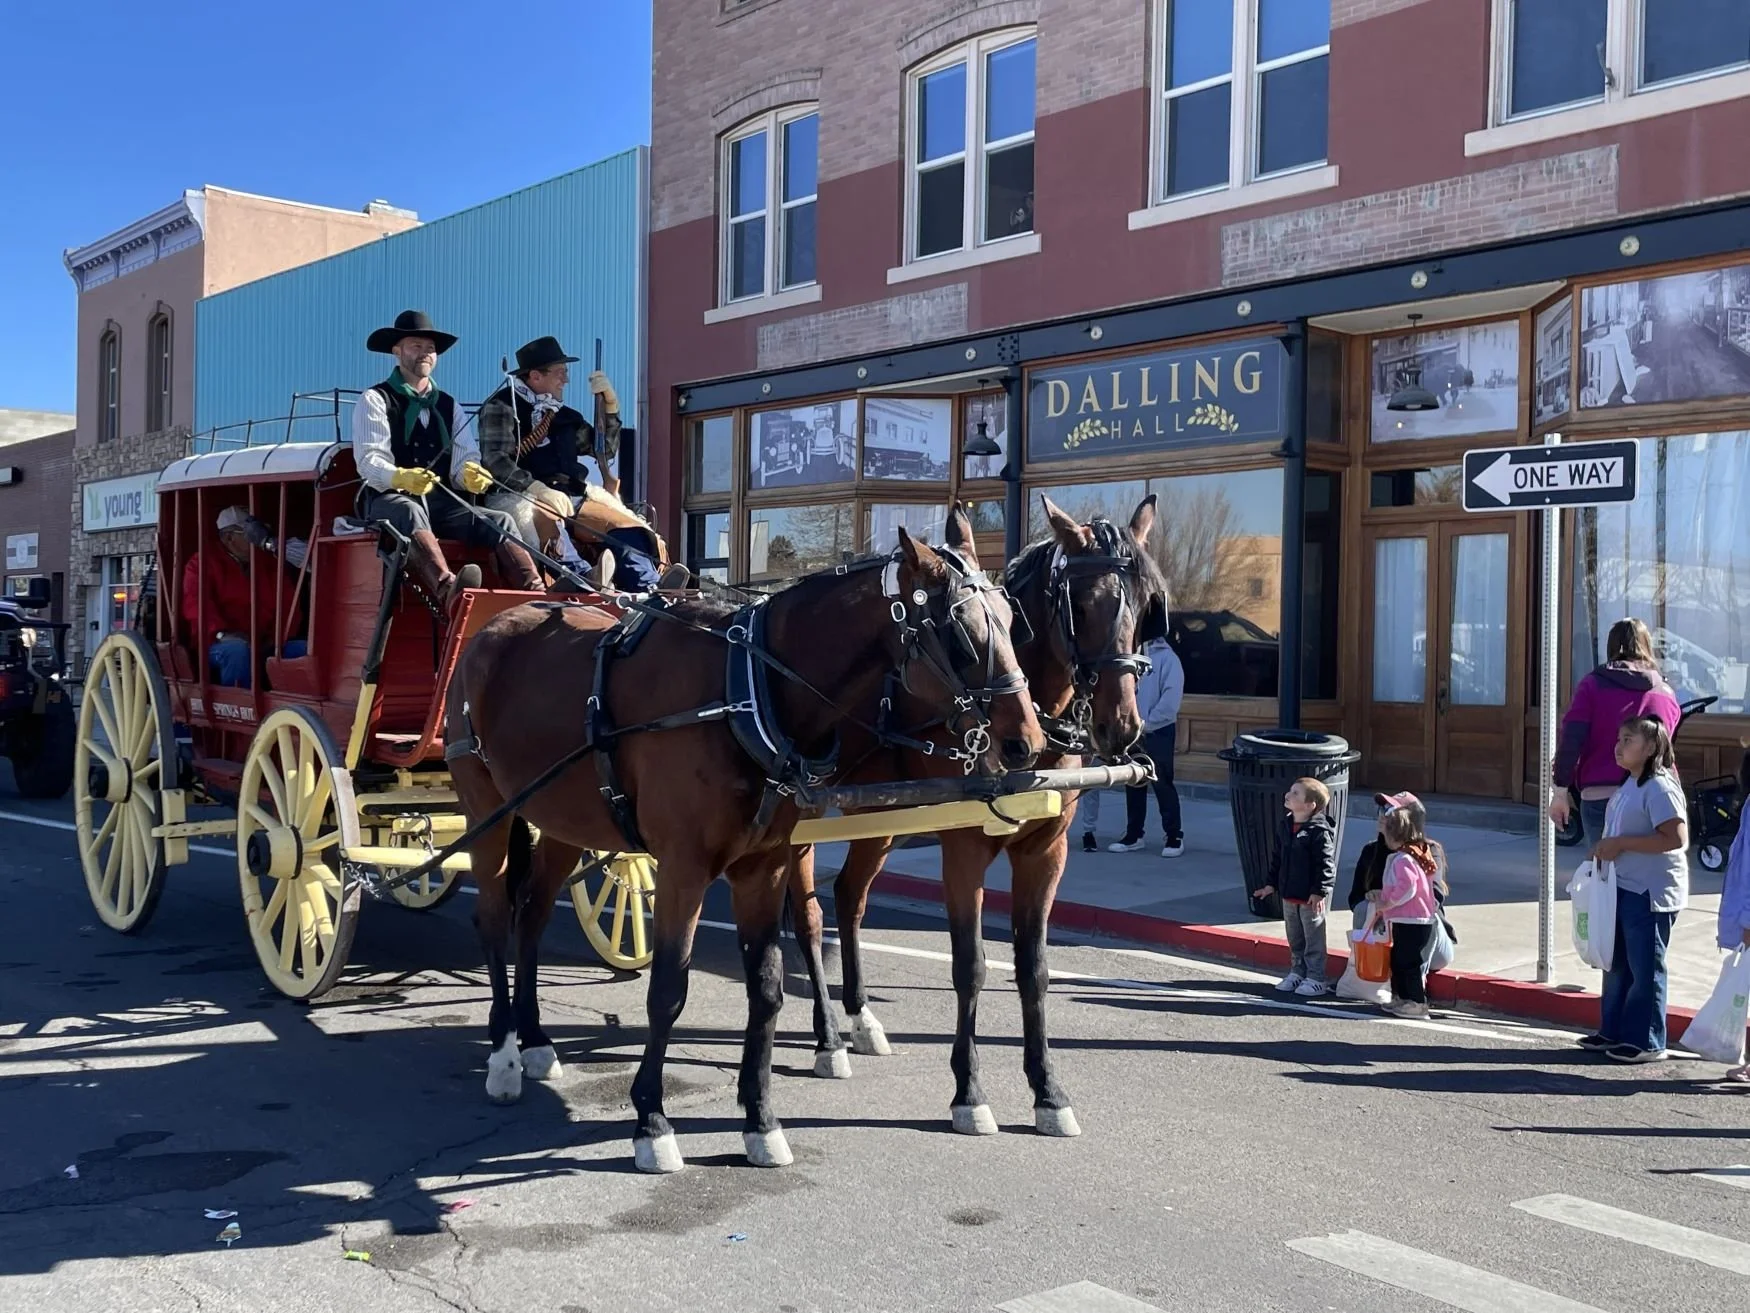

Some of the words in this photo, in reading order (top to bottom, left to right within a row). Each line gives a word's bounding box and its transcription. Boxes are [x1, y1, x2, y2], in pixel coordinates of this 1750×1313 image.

[1046, 351, 1262, 418] DALLING
[1111, 413, 1184, 440] HALL
[1513, 465, 1559, 489] ONE
[1568, 461, 1616, 486] WAY
[104, 490, 142, 527] young
